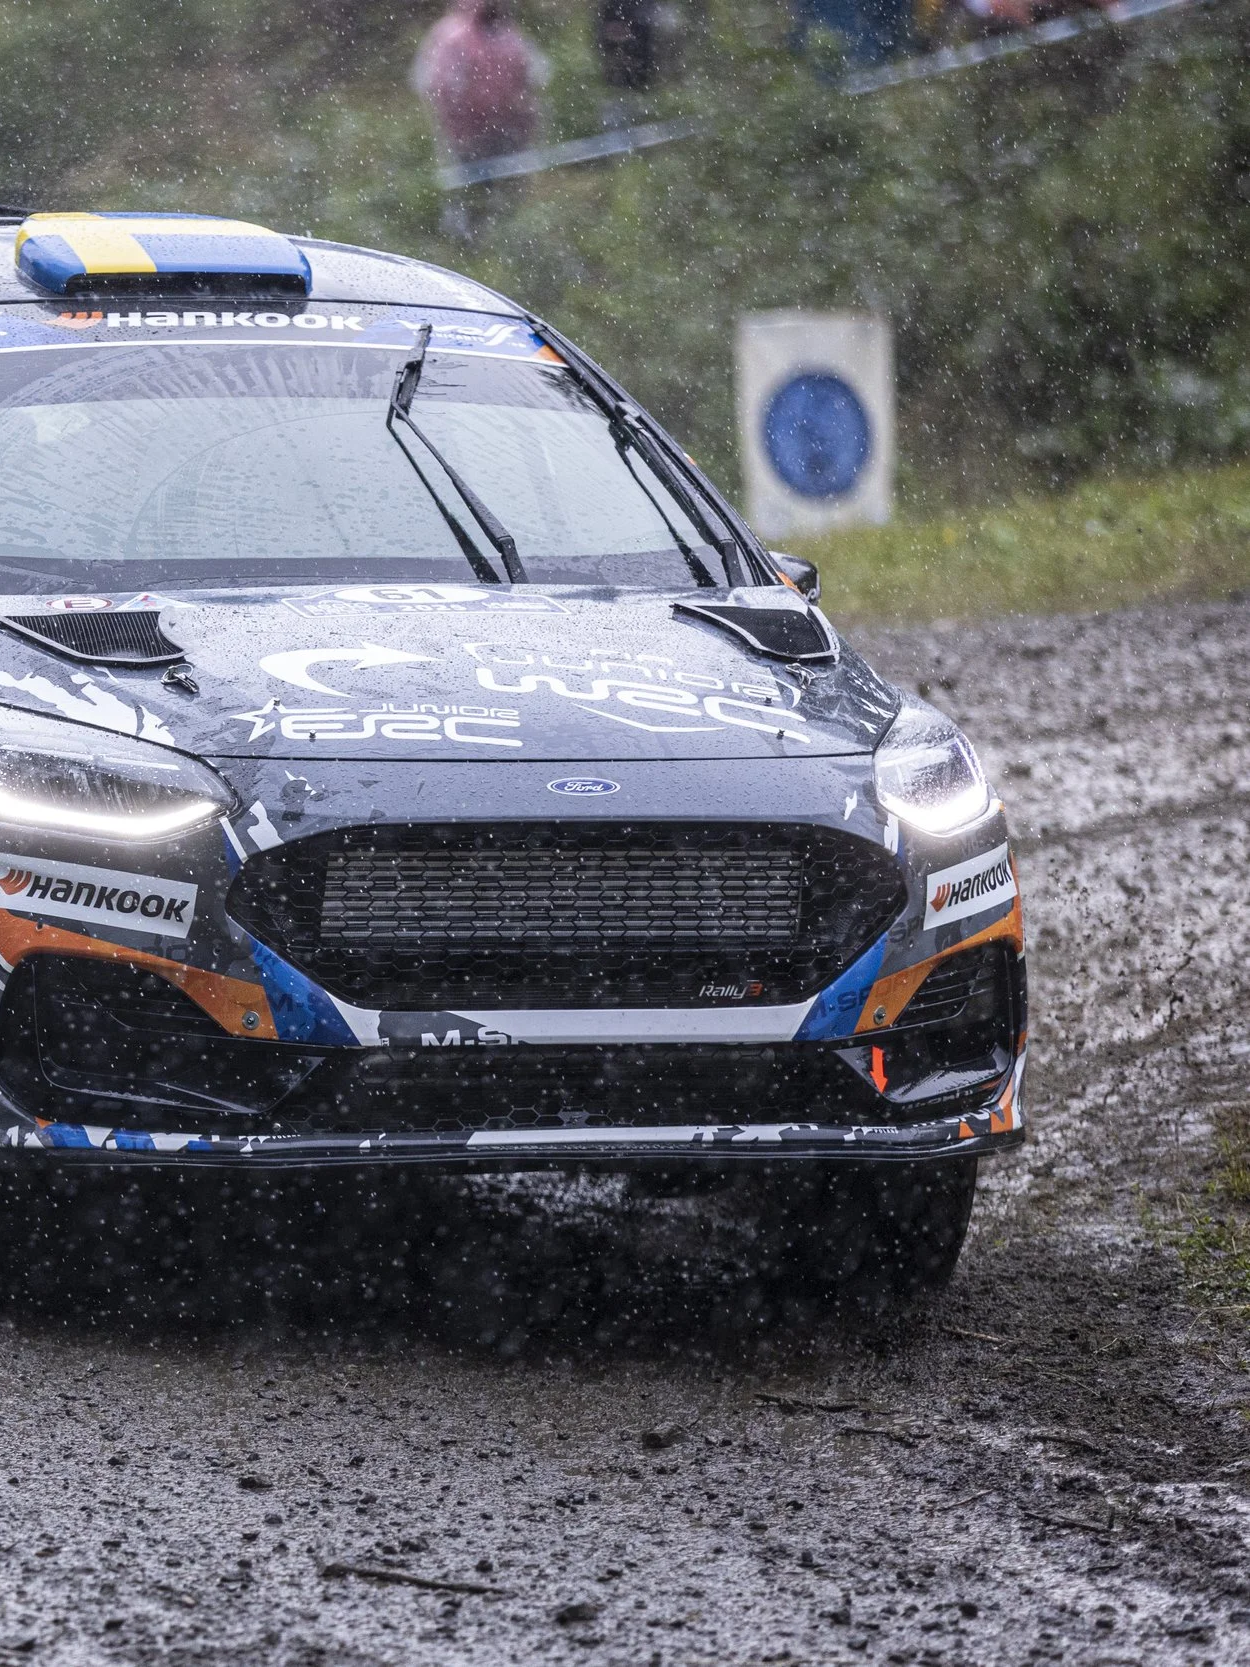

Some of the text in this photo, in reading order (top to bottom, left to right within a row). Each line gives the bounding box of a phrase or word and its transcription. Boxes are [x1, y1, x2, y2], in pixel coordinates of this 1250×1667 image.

[369, 589, 446, 600] 61
[398, 602, 466, 612] 2025
[359, 703, 520, 720] JUNIOR
[476, 668, 811, 744] WRC
[281, 714, 523, 747] ERC
[564, 781, 604, 792] Ford
